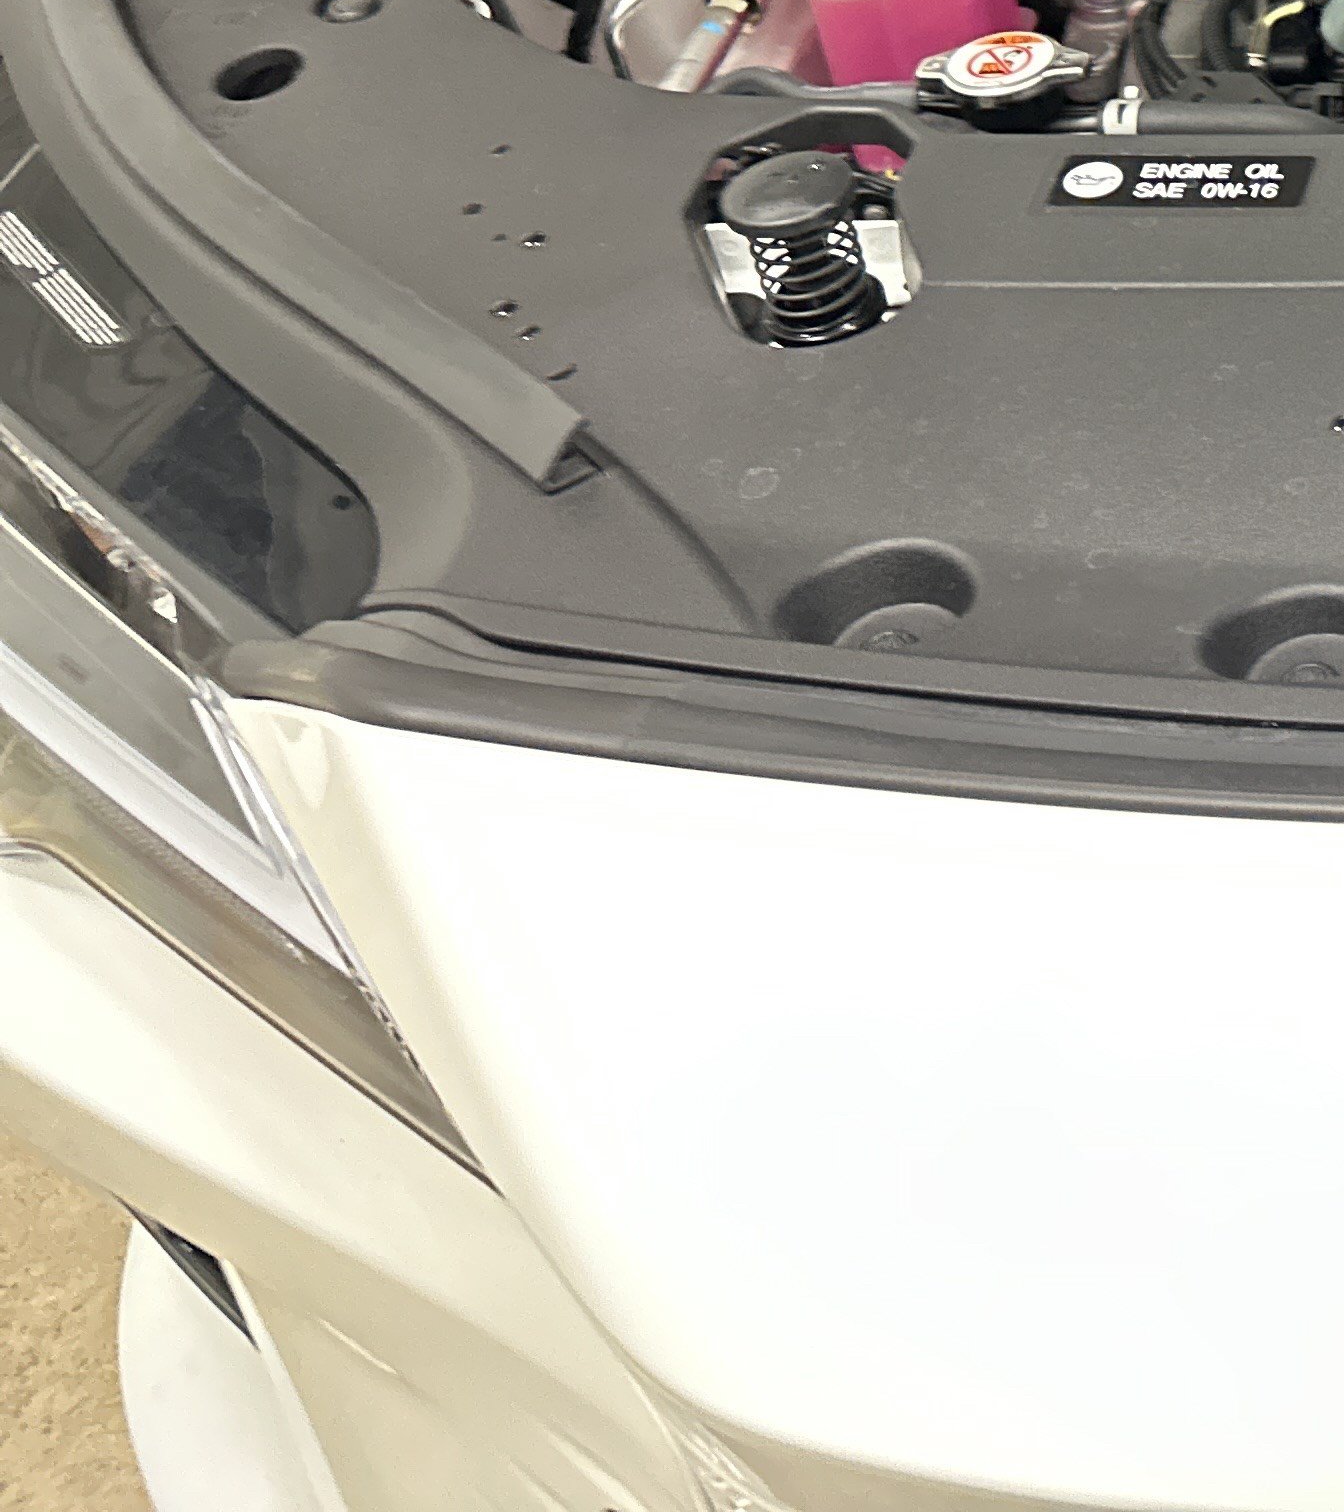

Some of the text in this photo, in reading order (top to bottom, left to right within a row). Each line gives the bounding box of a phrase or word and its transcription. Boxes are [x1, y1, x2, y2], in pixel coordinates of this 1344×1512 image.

[1139, 162, 1285, 180] ENGINE OIL
[1132, 181, 1280, 199] SAE 0W-16
